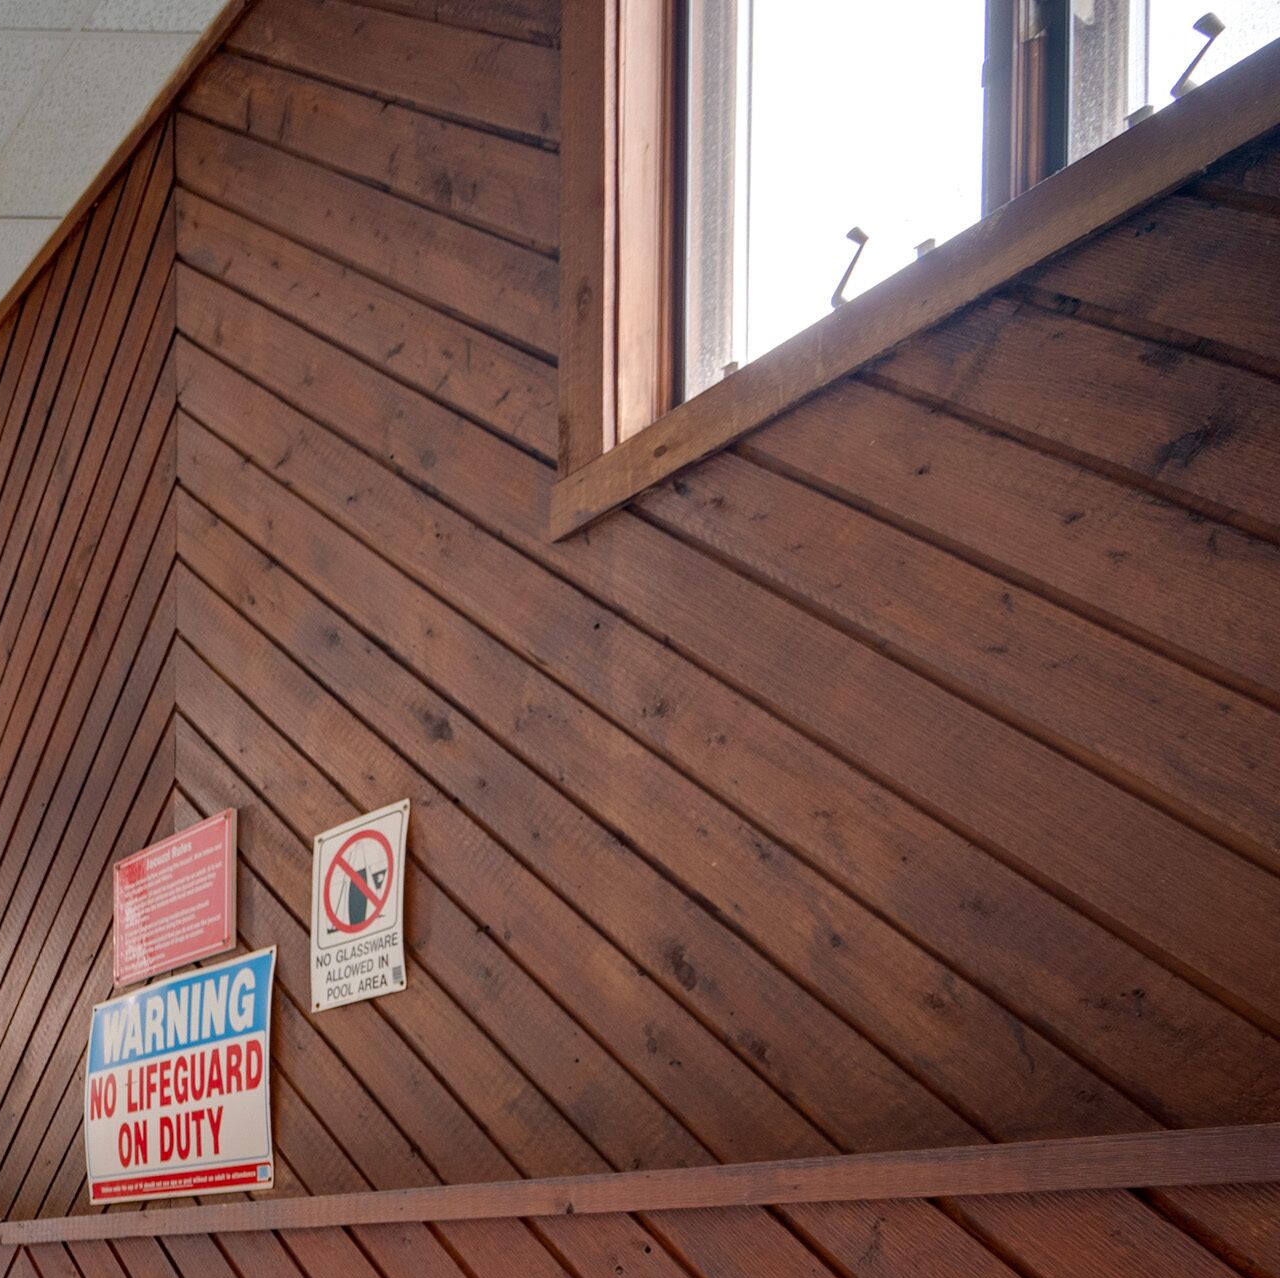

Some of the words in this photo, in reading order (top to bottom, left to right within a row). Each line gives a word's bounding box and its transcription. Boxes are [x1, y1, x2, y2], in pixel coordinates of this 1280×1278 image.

[171, 841, 193, 859] Rules
[316, 953, 332, 969] NO
[335, 932, 398, 963] GLASSWARE
[326, 958, 374, 984] ALLOWED
[378, 954, 389, 968] IN
[327, 983, 354, 1001] POOL
[358, 974, 388, 993] AREA
[103, 967, 256, 1065] WARNING
[90, 1073, 117, 1121] NO
[127, 1039, 263, 1113] LIFEGUARD
[118, 1120, 148, 1168] ON
[159, 1106, 223, 1162] DUTY
